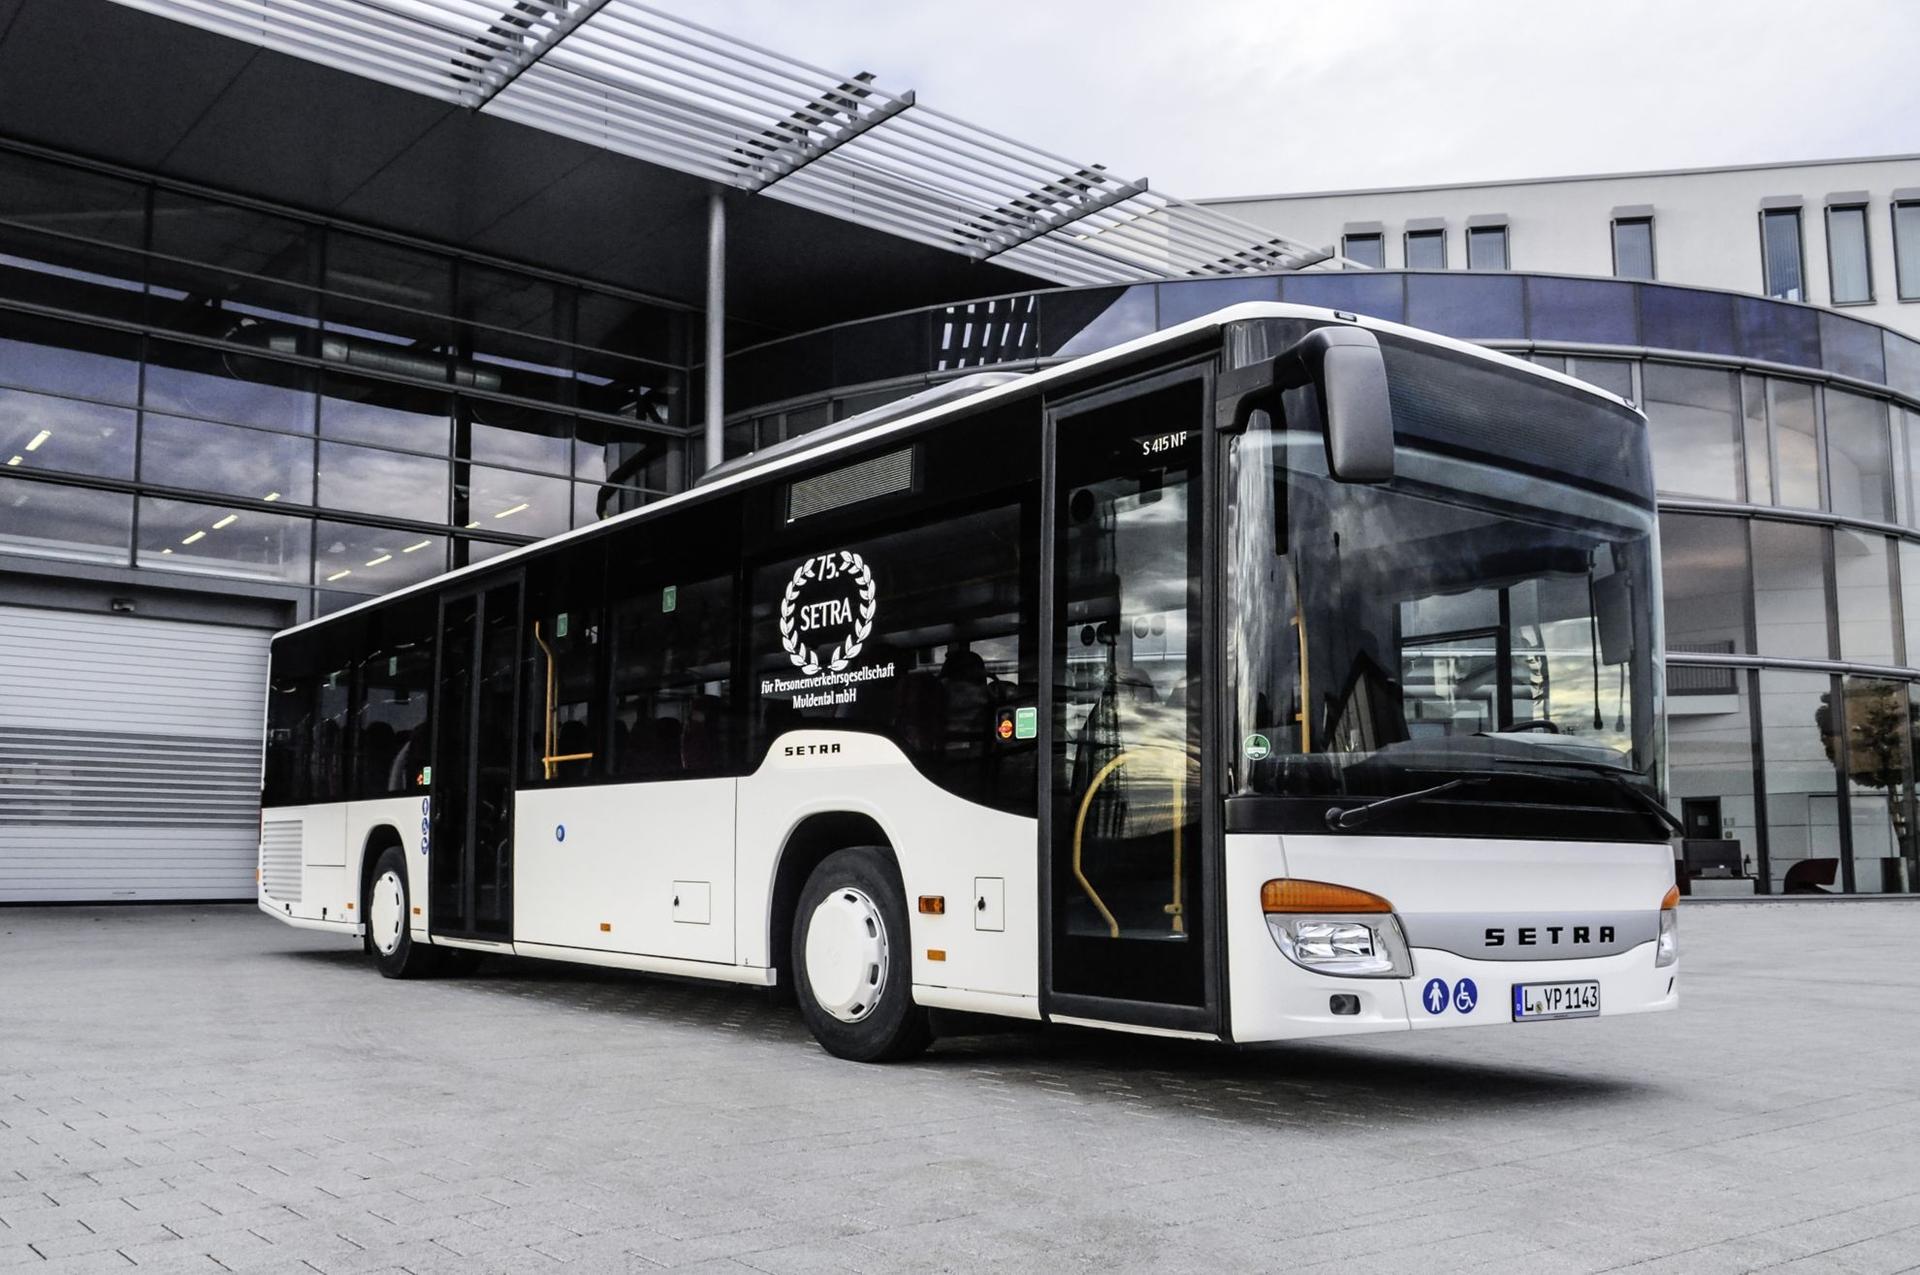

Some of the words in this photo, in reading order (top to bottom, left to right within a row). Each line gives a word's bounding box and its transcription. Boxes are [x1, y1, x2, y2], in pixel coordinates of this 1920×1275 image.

[1143, 441, 1150, 456] S
[1151, 435, 1169, 453] 415
[1170, 431, 1187, 448] NF
[817, 553, 839, 581] 75.
[800, 597, 853, 631] SETRA
[761, 680, 774, 695] für
[774, 662, 895, 692] Personenverkehrsgesellschaft
[792, 690, 834, 709] Muldental
[835, 688, 857, 704] mbH
[785, 743, 841, 756] SETRA
[1484, 926, 1615, 947] SETRA
[1524, 989, 1534, 1011] L
